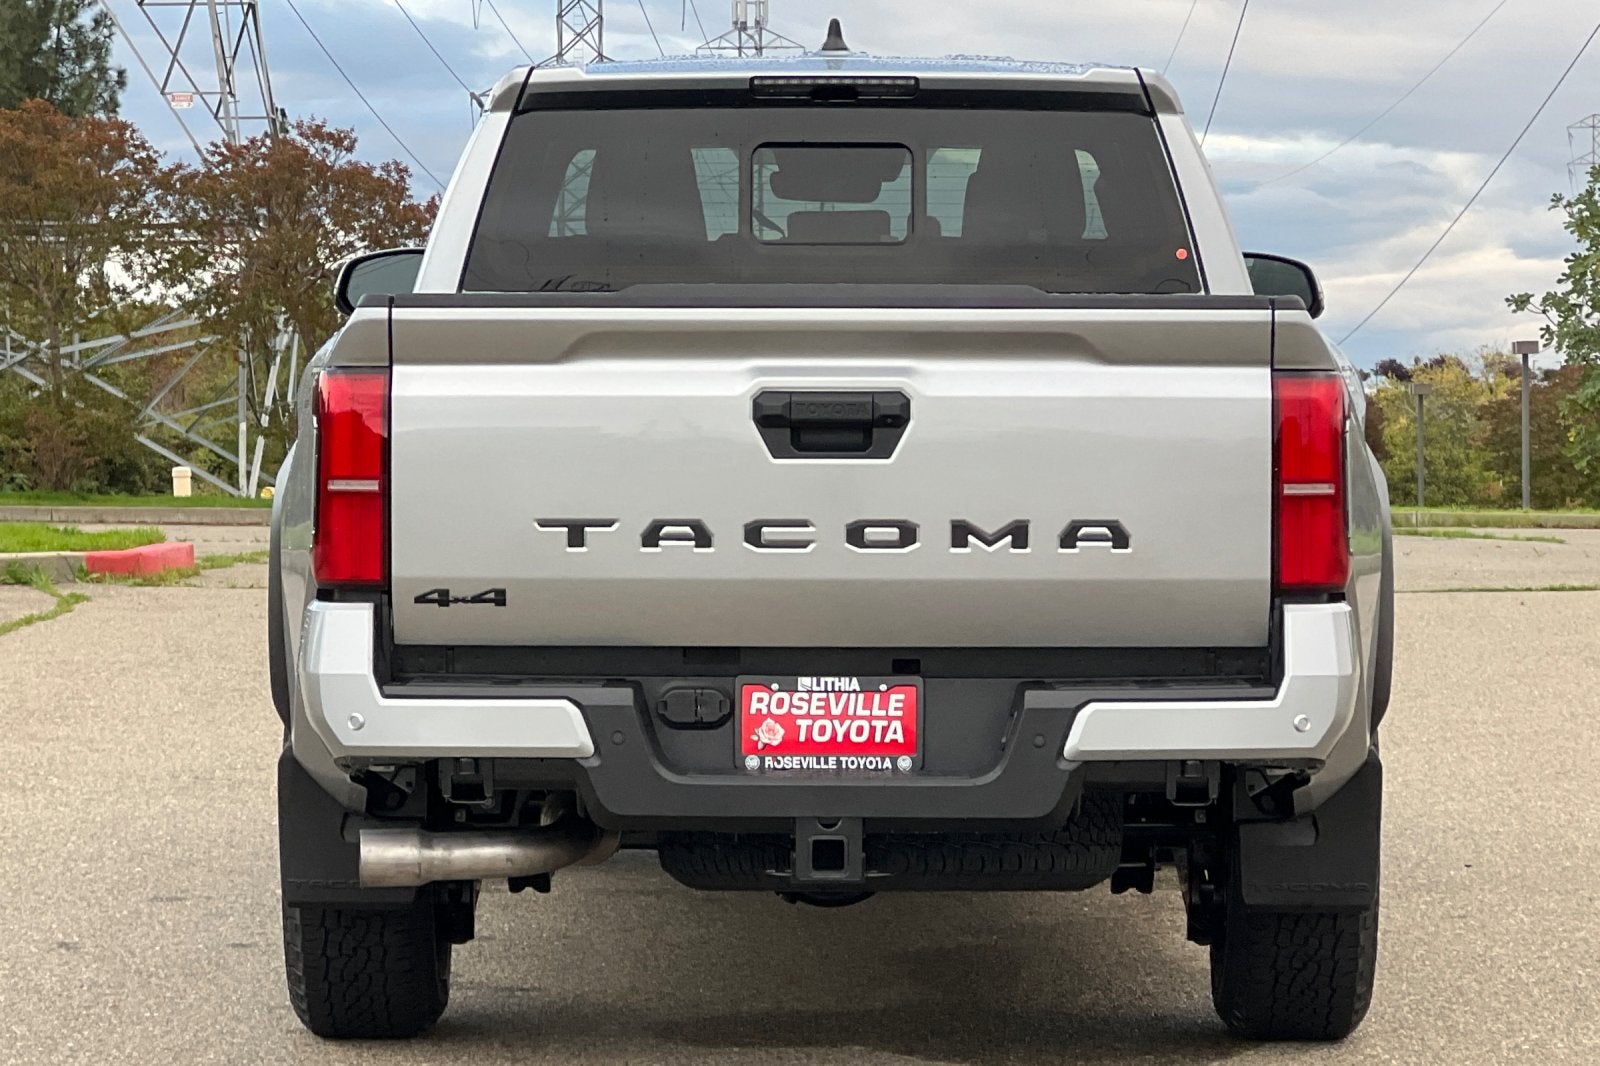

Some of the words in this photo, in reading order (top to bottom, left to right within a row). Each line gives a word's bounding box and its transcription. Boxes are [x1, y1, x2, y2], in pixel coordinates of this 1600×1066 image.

[535, 518, 1133, 555] TACOMA
[812, 676, 861, 691] LITHIA
[750, 691, 905, 716] ROSEVILLE
[796, 719, 904, 743] TOYOTA
[764, 756, 837, 769] ROSEVILLE
[840, 757, 893, 770] TOYOTA
